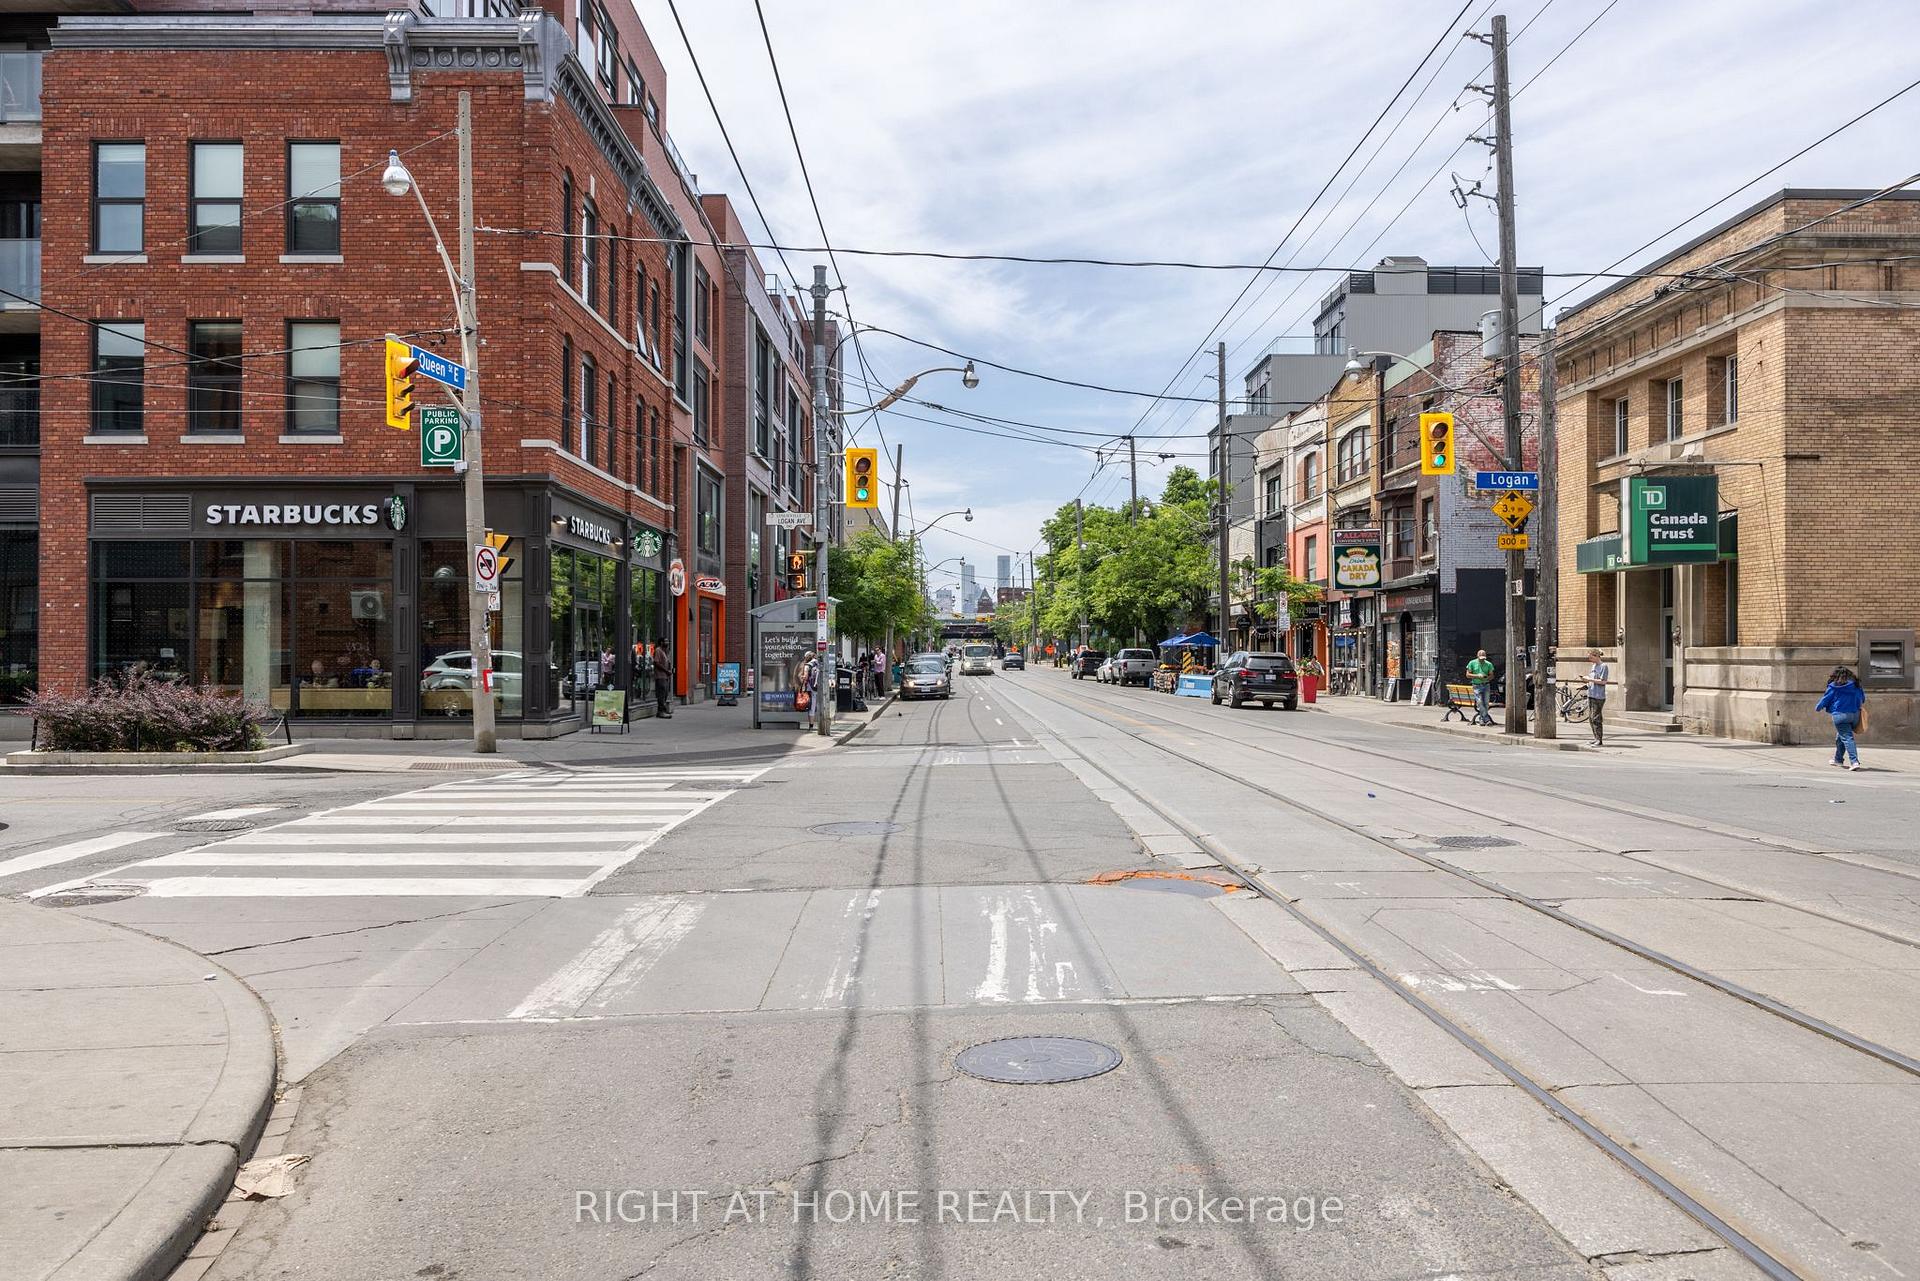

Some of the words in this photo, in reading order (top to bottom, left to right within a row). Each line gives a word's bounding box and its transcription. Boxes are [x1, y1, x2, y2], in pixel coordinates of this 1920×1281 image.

[419, 352, 446, 378] Queen
[454, 368, 459, 382] E
[434, 430, 451, 452] P
[1491, 474, 1529, 488] Logan
[1642, 490, 1663, 505] TD
[206, 504, 378, 524] STARBUCKS
[1650, 513, 1708, 524] Canada
[571, 515, 610, 545] STARBUCKS
[1651, 527, 1694, 539] Trust
[1500, 537, 1517, 545] 300
[1341, 564, 1376, 572] CANADA
[780, 643, 802, 651] vision
